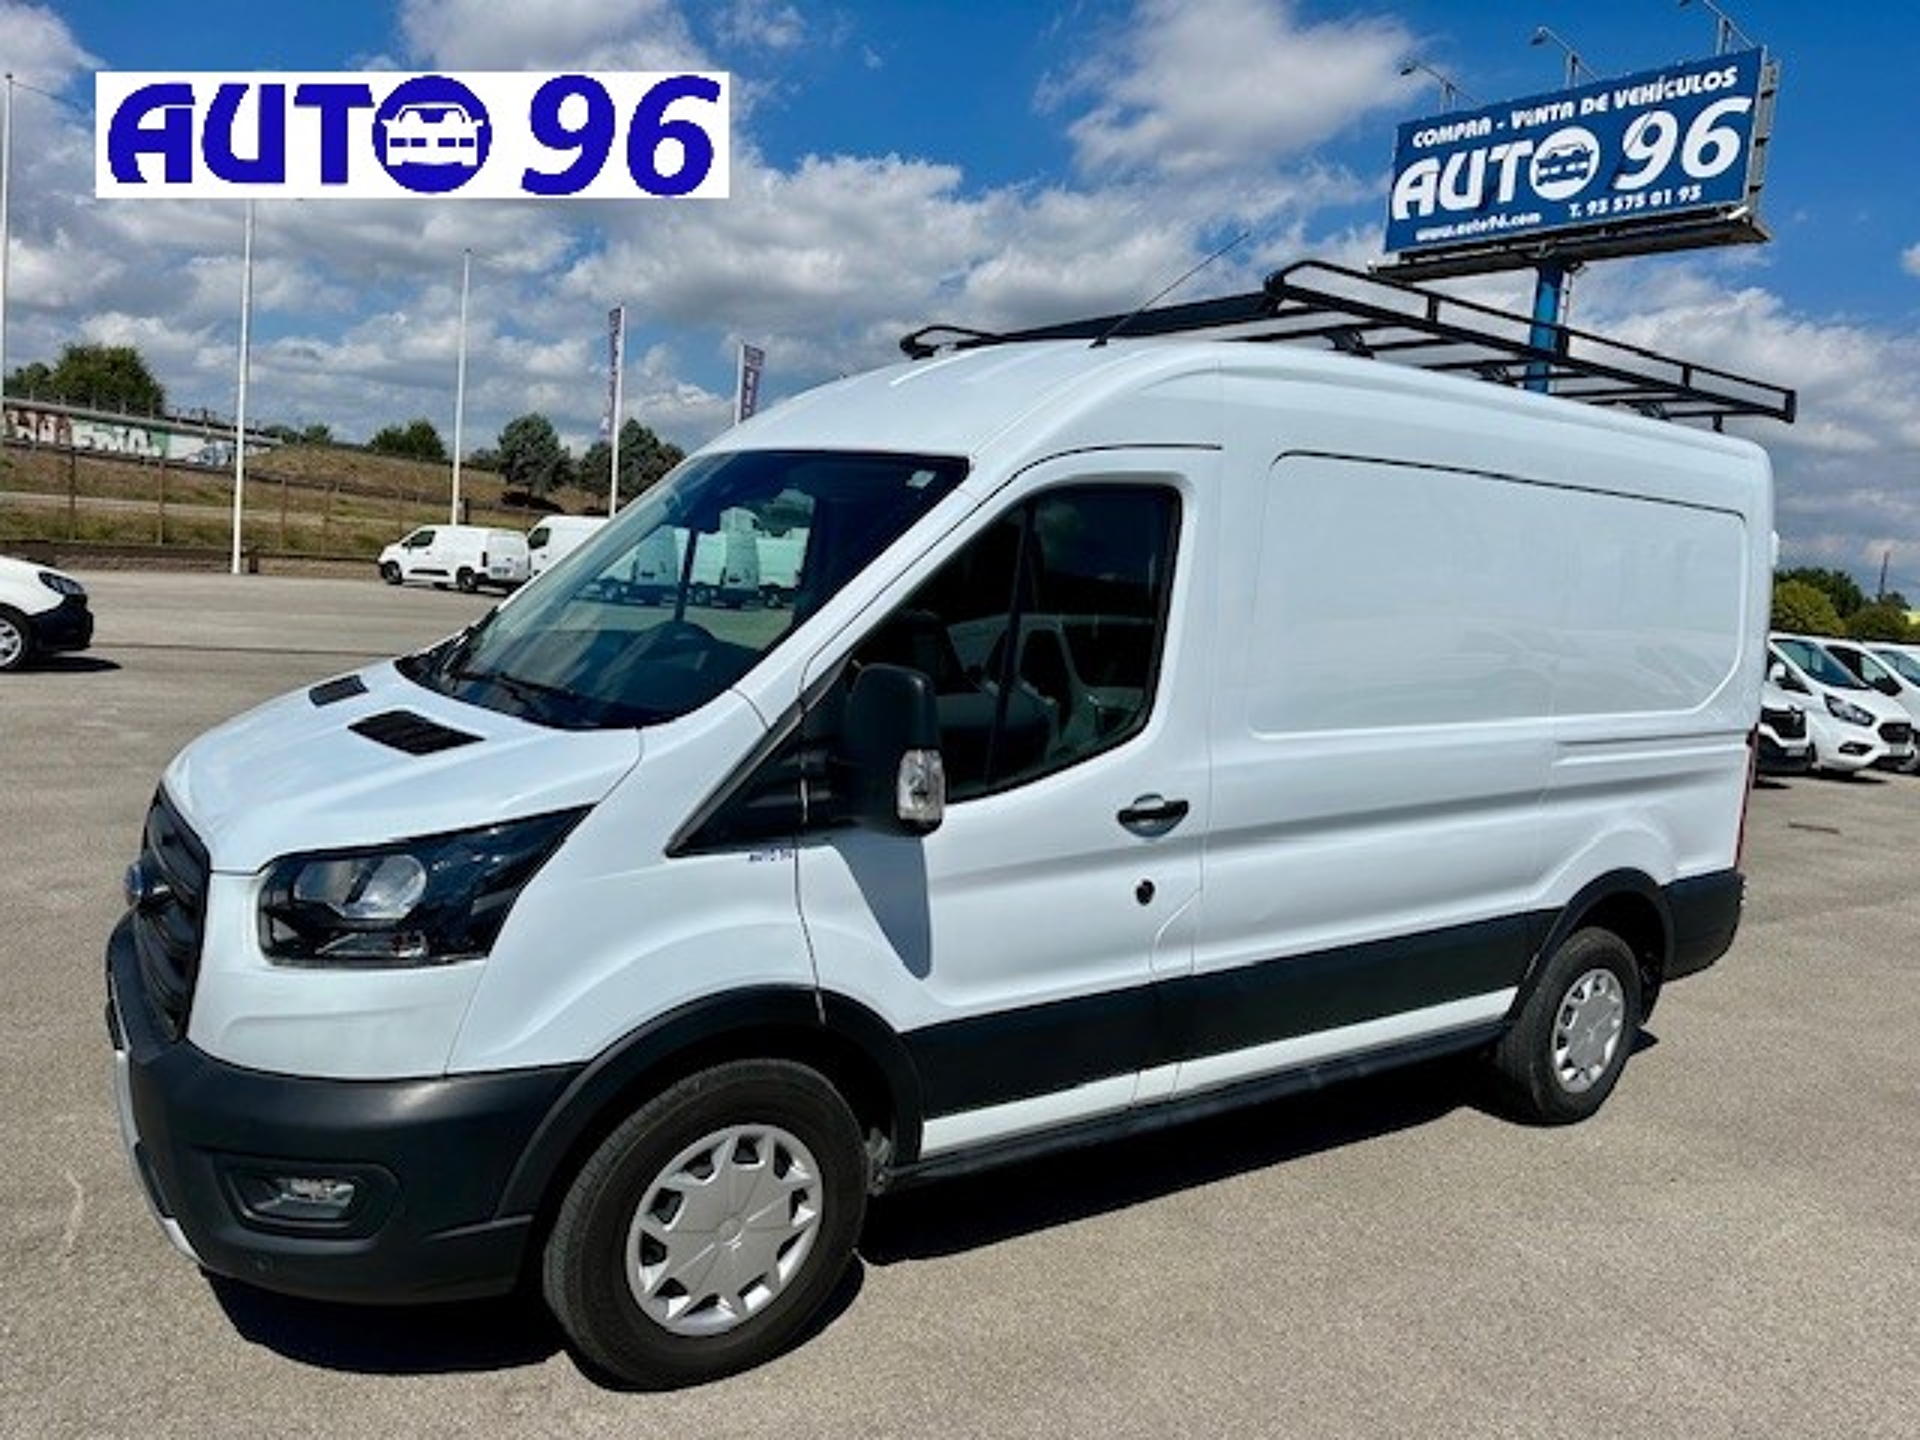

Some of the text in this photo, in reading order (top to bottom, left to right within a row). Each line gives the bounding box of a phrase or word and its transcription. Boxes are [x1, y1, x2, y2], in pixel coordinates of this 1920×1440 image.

[1413, 116, 1491, 147] COMPRA
[1580, 93, 1608, 115] DE
[1614, 66, 1737, 109] VEHÍCULOS
[1392, 98, 1752, 220] AUTO 96
